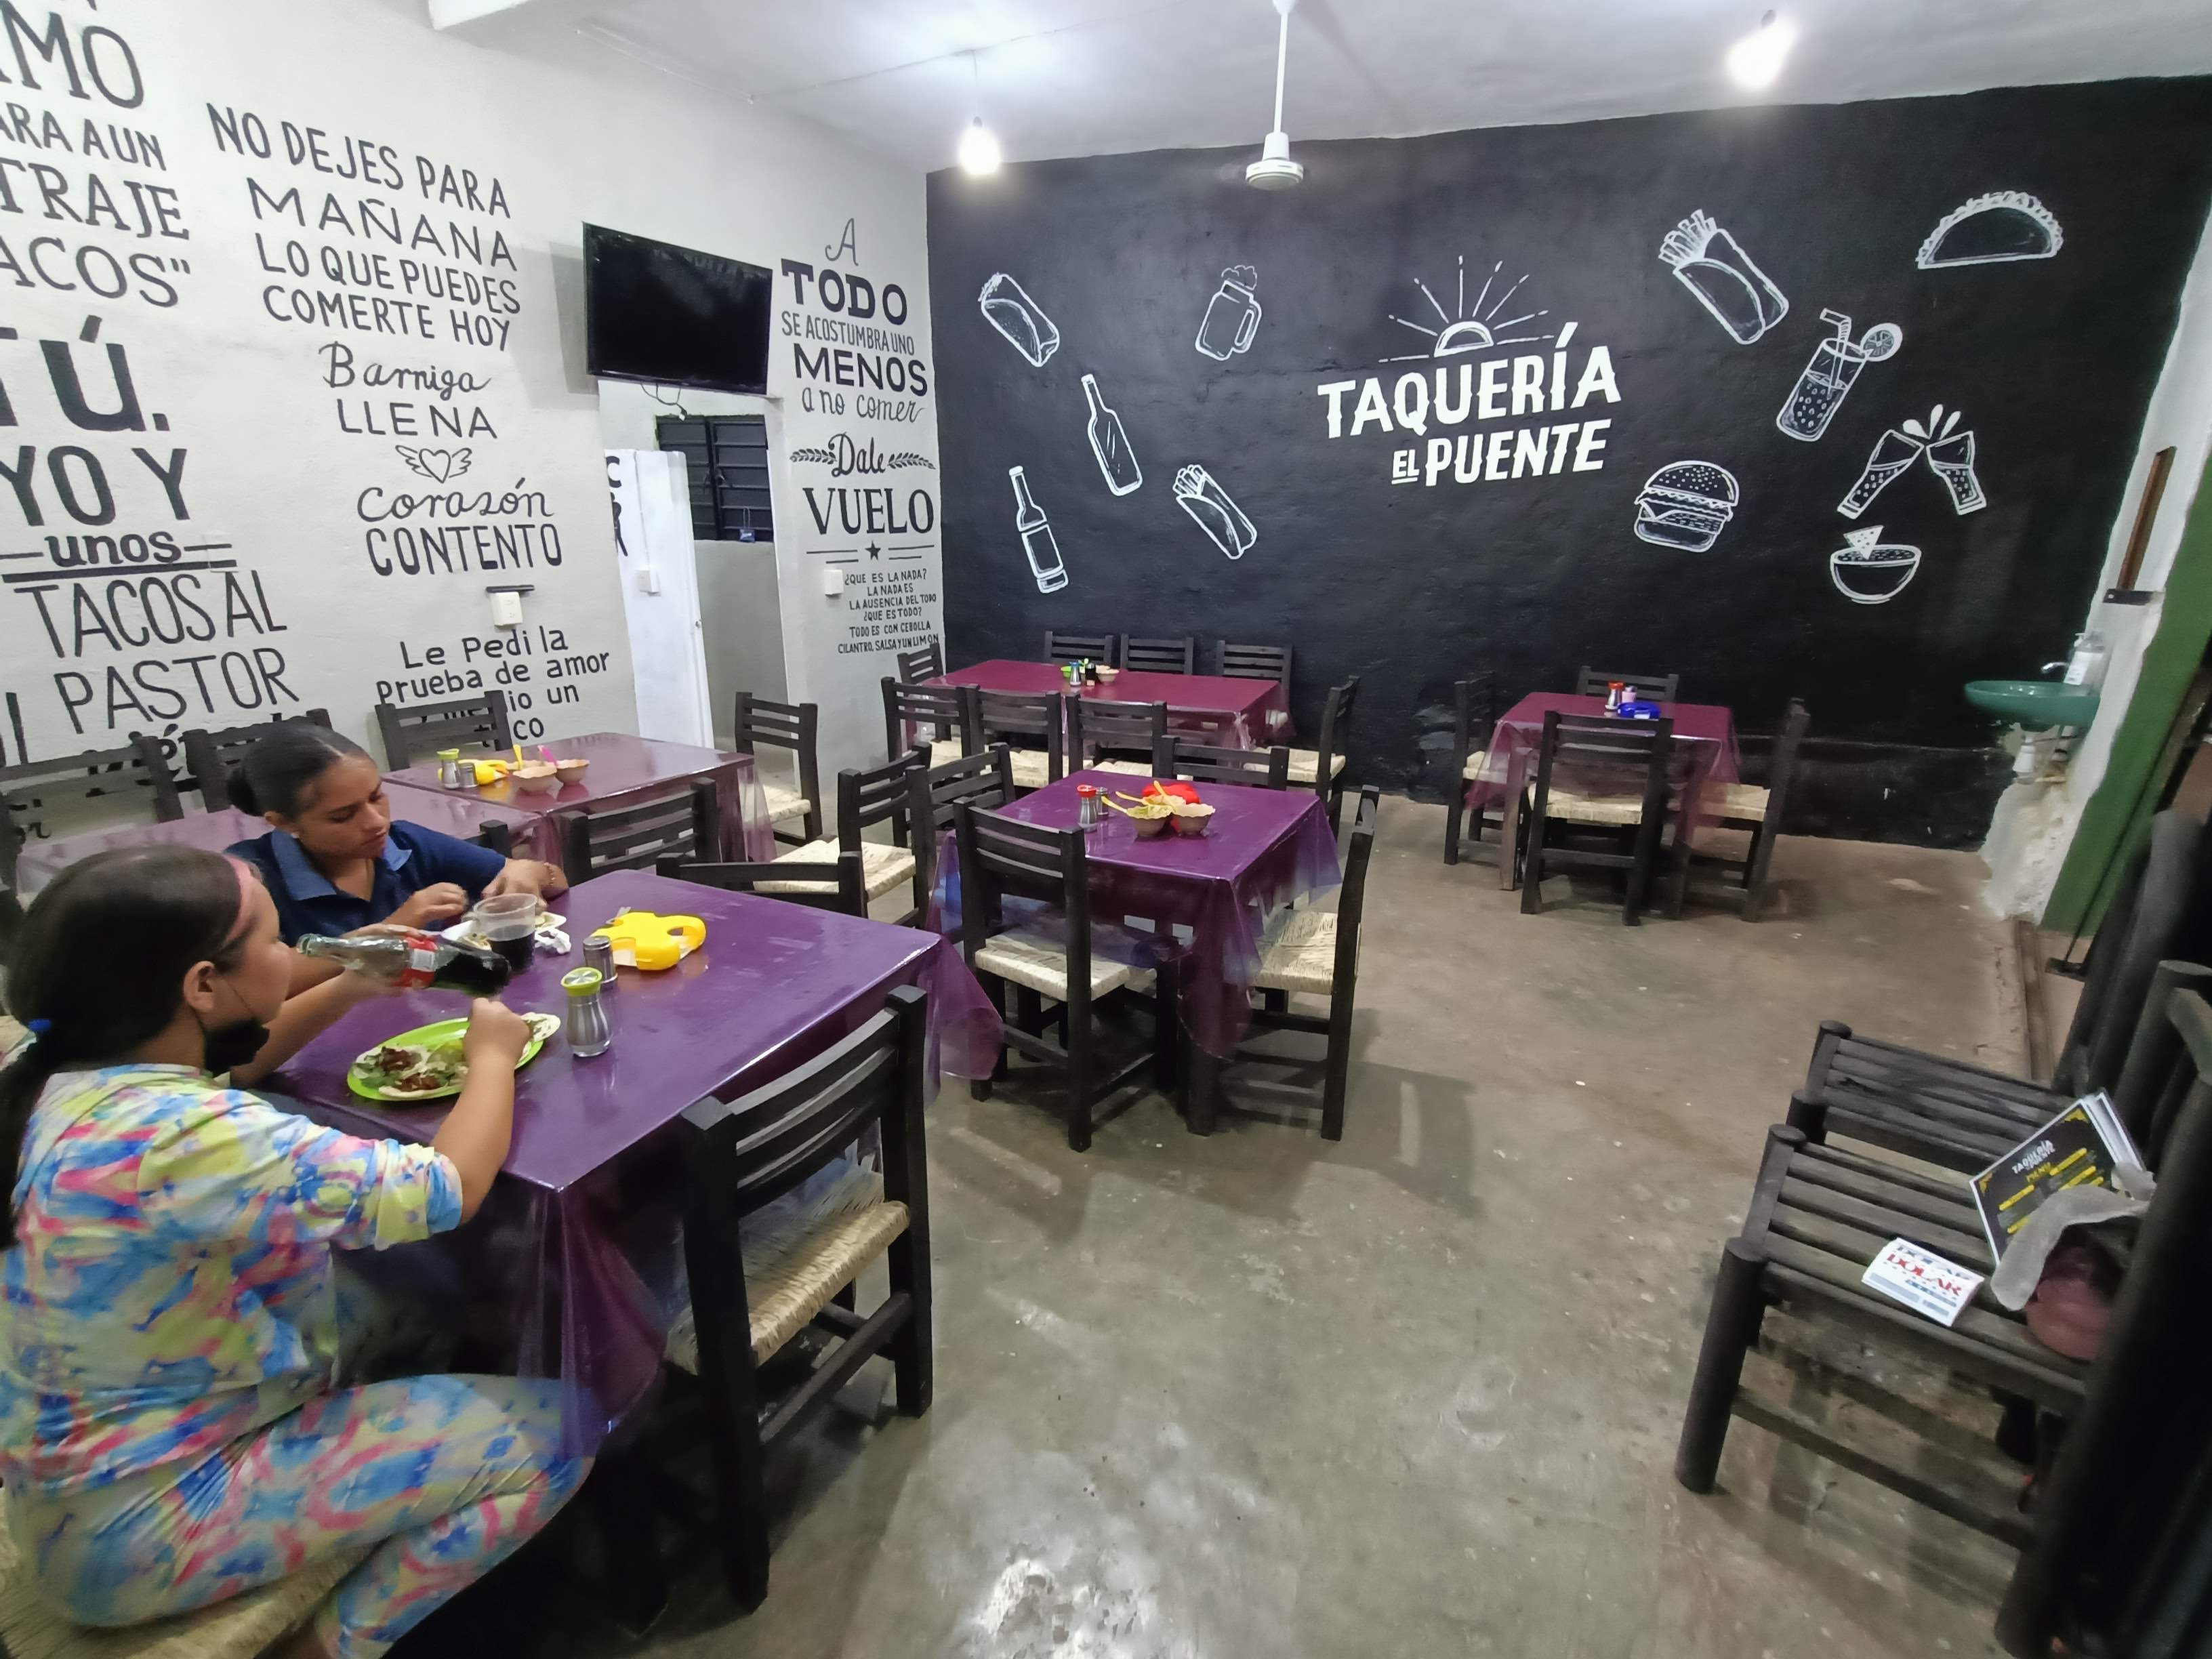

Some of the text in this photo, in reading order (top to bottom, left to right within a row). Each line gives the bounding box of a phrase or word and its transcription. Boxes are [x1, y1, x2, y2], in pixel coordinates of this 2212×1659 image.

[206, 103, 510, 218] NO DEJES PARA
[246, 177, 518, 272] MAÑANA
[255, 233, 520, 314] LO QUE PUEDES
[781, 258, 907, 325] TODO
[264, 285, 510, 351] COMERTE HOY
[781, 311, 914, 355] SE ACOSTUMBRA UNO
[0, 313, 171, 434] Ú.
[793, 342, 928, 397] MENOS
[1317, 321, 1622, 439] TAQUERÍA
[337, 399, 497, 438] LLENA
[819, 390, 845, 415] no
[857, 395, 922, 423] comer
[827, 431, 886, 478] Dale
[1391, 417, 1612, 487] EL PUENTE
[0, 444, 190, 527] YO Y
[357, 477, 554, 522] Corazón
[802, 488, 934, 535] VUELO
[43, 531, 182, 568] unos
[366, 524, 562, 576] CONTENTO
[867, 582, 914, 596] LA NADA ES
[872, 573, 884, 583] ES
[888, 571, 899, 582] LA
[901, 568, 927, 581] NADA?
[14, 569, 288, 659] TACOS AL
[849, 593, 937, 610] LA AUSENCIA DEL TODO
[886, 610, 897, 619] ES
[897, 607, 922, 618] TODO?
[400, 626, 568, 669] Le Pedi la
[849, 620, 932, 638] TODO ES CON CEBOLLA
[875, 638, 897, 651] SALSA
[495, 661, 530, 684] de
[547, 653, 609, 678] amor
[54, 648, 300, 737] PASTOR
[547, 684, 579, 704] un
